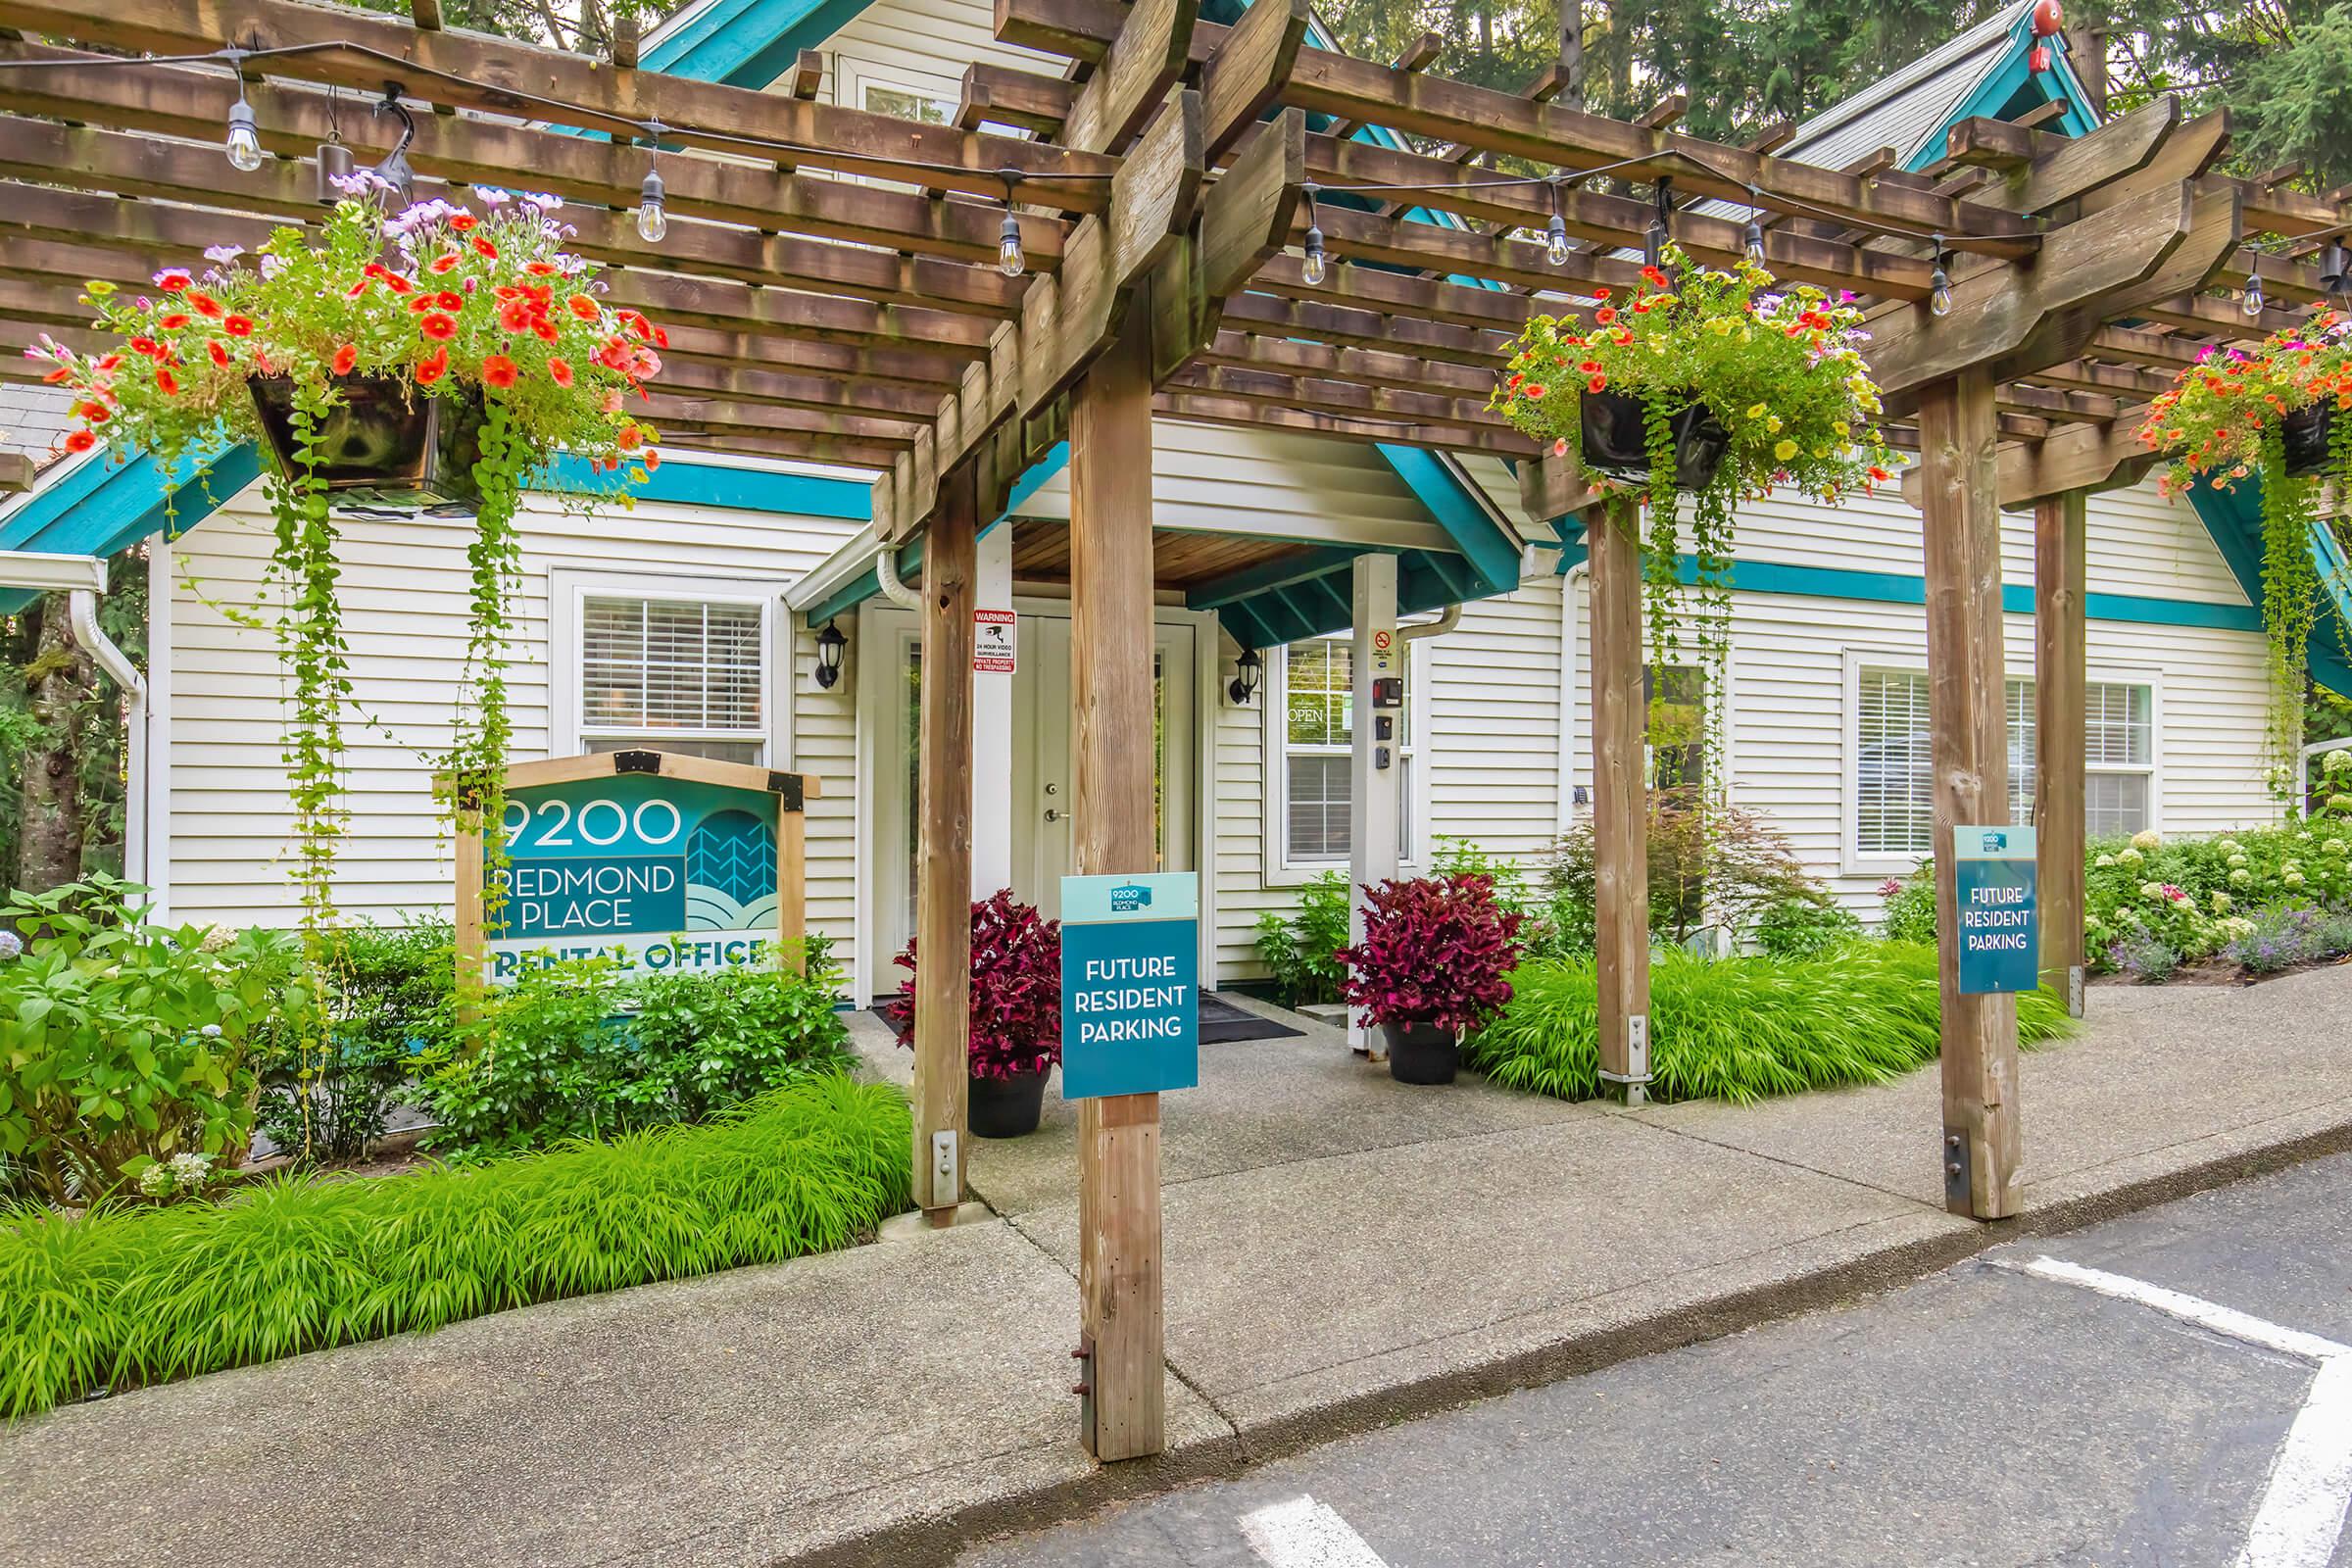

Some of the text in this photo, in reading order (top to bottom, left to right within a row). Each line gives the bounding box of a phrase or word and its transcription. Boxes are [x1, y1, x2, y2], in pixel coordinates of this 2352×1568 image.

[975, 612, 1013, 622] WARNING
[1288, 709, 1323, 722] OPEN
[503, 799, 682, 847] 9200
[493, 865, 675, 898] REDMOND
[1112, 889, 1139, 899] 9200
[1971, 887, 2023, 904] FUTURE
[521, 899, 632, 930] PLACE
[1965, 910, 2030, 927] RESIDENT
[1969, 933, 2027, 951] PARKING
[1086, 956, 1176, 981] FUTURE
[1075, 985, 1188, 1013] RESIDENT
[1081, 1016, 1182, 1044] PARKING
